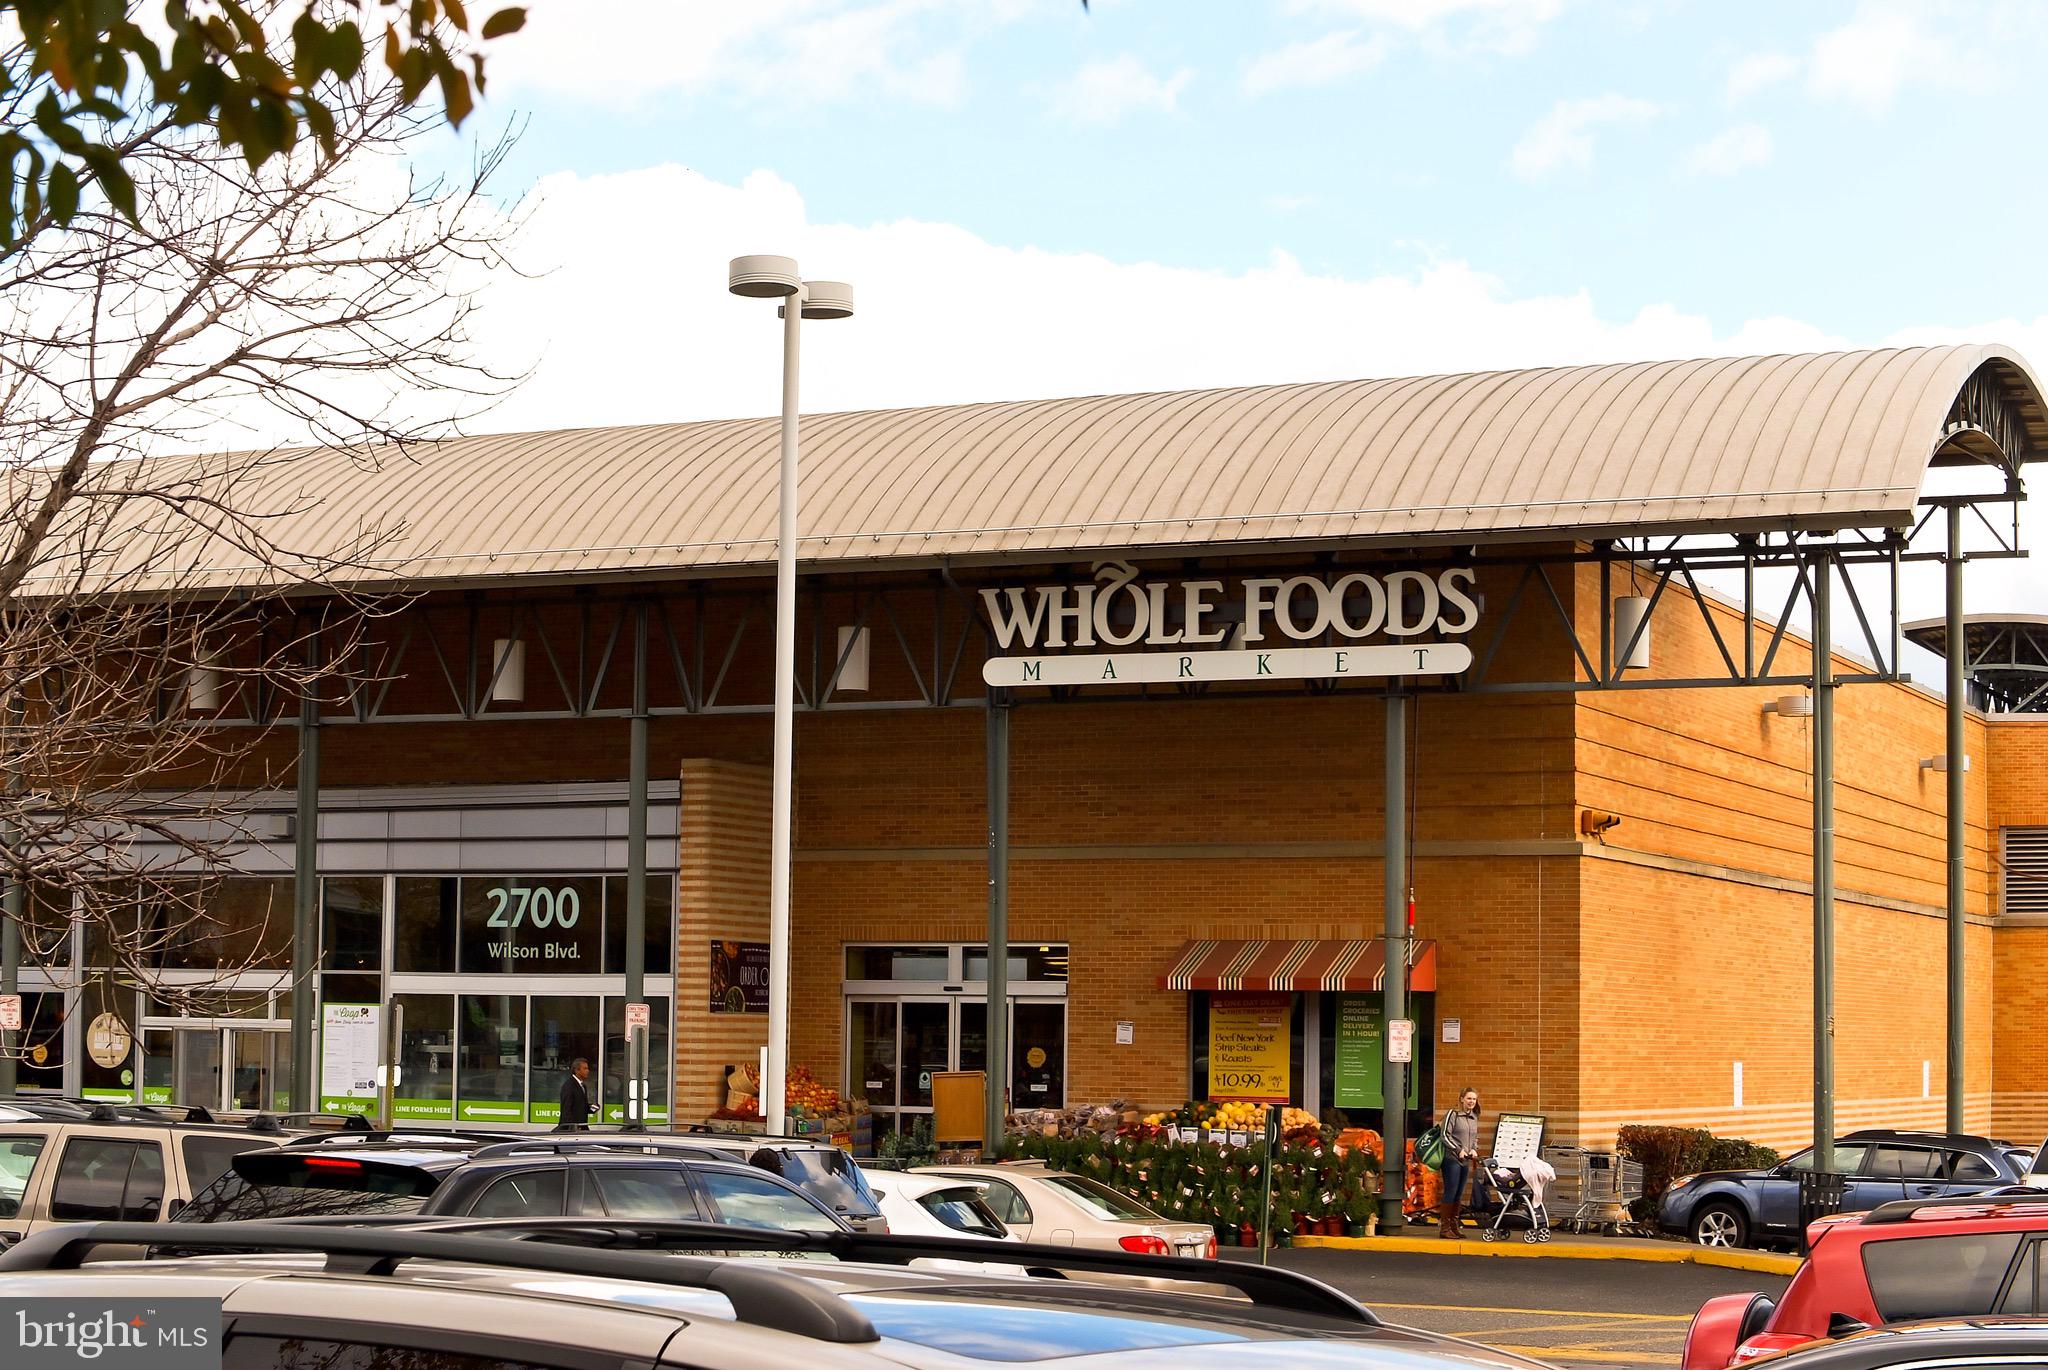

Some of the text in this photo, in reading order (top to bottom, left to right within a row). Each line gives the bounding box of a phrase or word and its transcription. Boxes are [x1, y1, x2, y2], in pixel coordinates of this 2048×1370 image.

[978, 560, 1479, 649] WHOLE FOODS
[1022, 649, 1429, 681] MARKET
[486, 886, 580, 929] 2700
[487, 941, 581, 959] Wilson Blvd.
[739, 966, 759, 986] ORDER
[1215, 1033, 1275, 1042] Beef New York
[1215, 1043, 1266, 1052] Strip Steaks
[1221, 1053, 1253, 1062] Roasts
[395, 1105, 414, 1113] LINE
[434, 1106, 452, 1114] HERE
[535, 1109, 553, 1117] LINE
